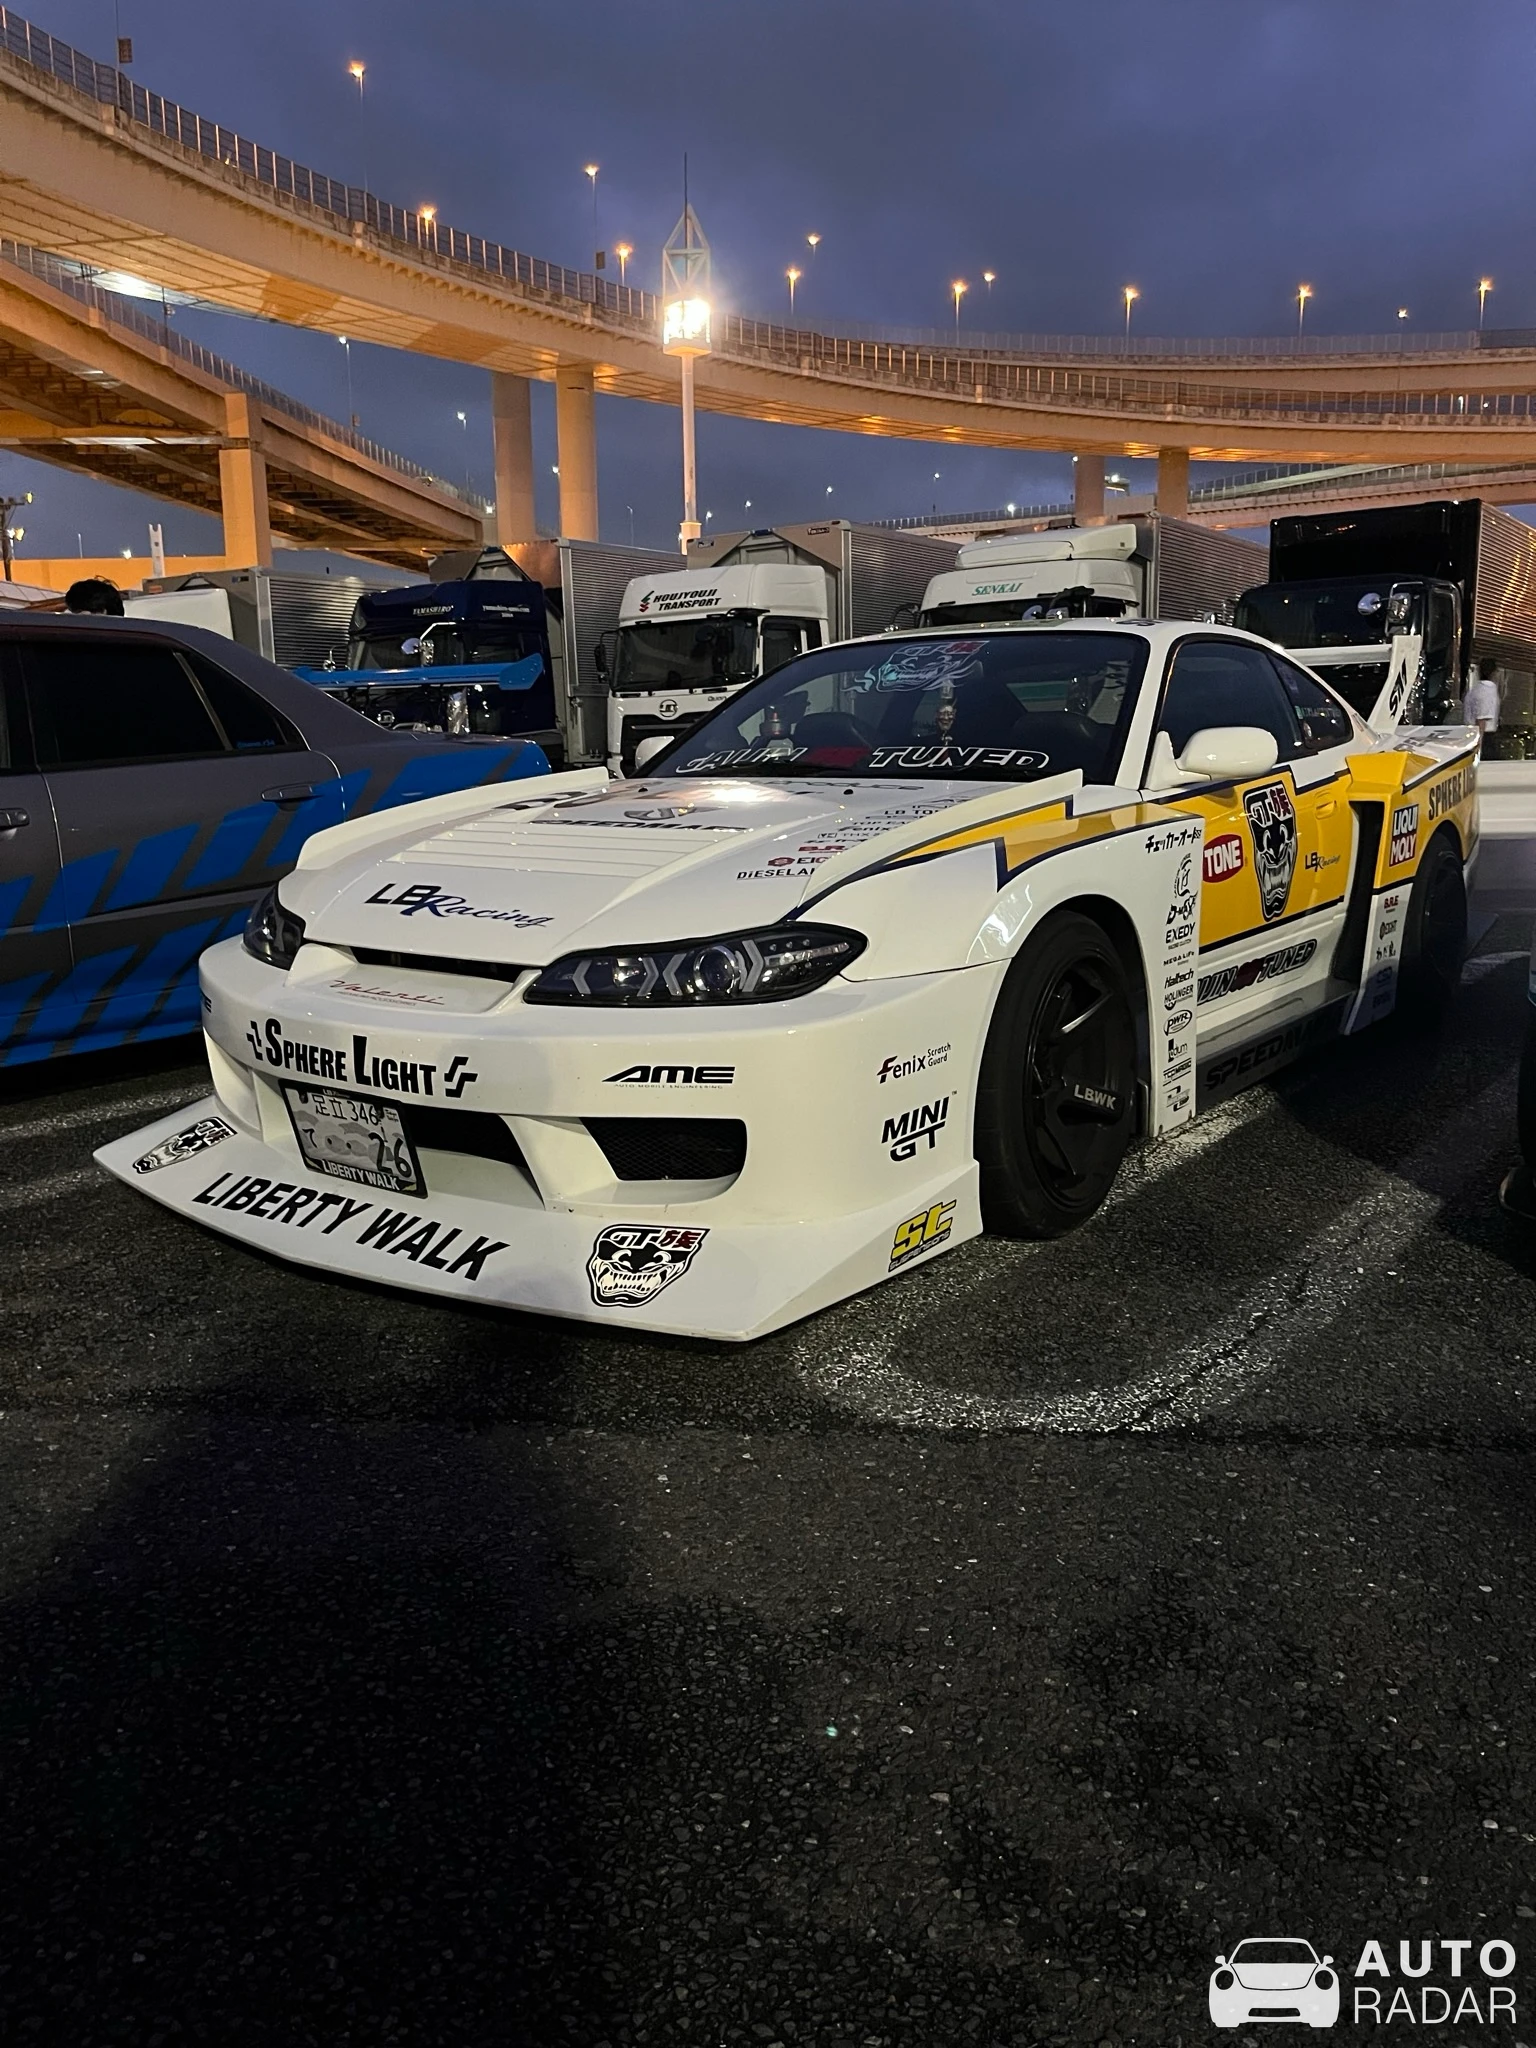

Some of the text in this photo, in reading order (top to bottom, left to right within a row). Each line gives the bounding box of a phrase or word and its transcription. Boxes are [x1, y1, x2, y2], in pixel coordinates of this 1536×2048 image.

[653, 588, 718, 603] HOUJYOUJI
[972, 582, 1023, 596] SENKAI
[658, 597, 722, 612] TRANSPORT
[868, 746, 1050, 769] TUNED
[1393, 804, 1419, 837] LIQUI
[1203, 839, 1241, 877] TONE
[1390, 834, 1417, 866] MOLY
[400, 895, 555, 928] Racing
[1166, 922, 1195, 944] EXEDY
[1257, 940, 1317, 983] TUNED
[1164, 968, 1194, 989] Haltech
[265, 1018, 437, 1096] SPHERE LIGHT
[927, 1042, 952, 1057] Scratch
[927, 1053, 947, 1067] Guard
[602, 1065, 735, 1084] AME
[877, 1055, 926, 1084] Fenix
[312, 1093, 347, 1120] 足立
[347, 1101, 380, 1126] 346
[1074, 1084, 1116, 1110] LBWK
[881, 1096, 949, 1144] MINI
[890, 1121, 946, 1162] GT
[322, 1159, 400, 1191] LIBERTY WALK
[192, 1172, 511, 1281] LIBERTY WALK
